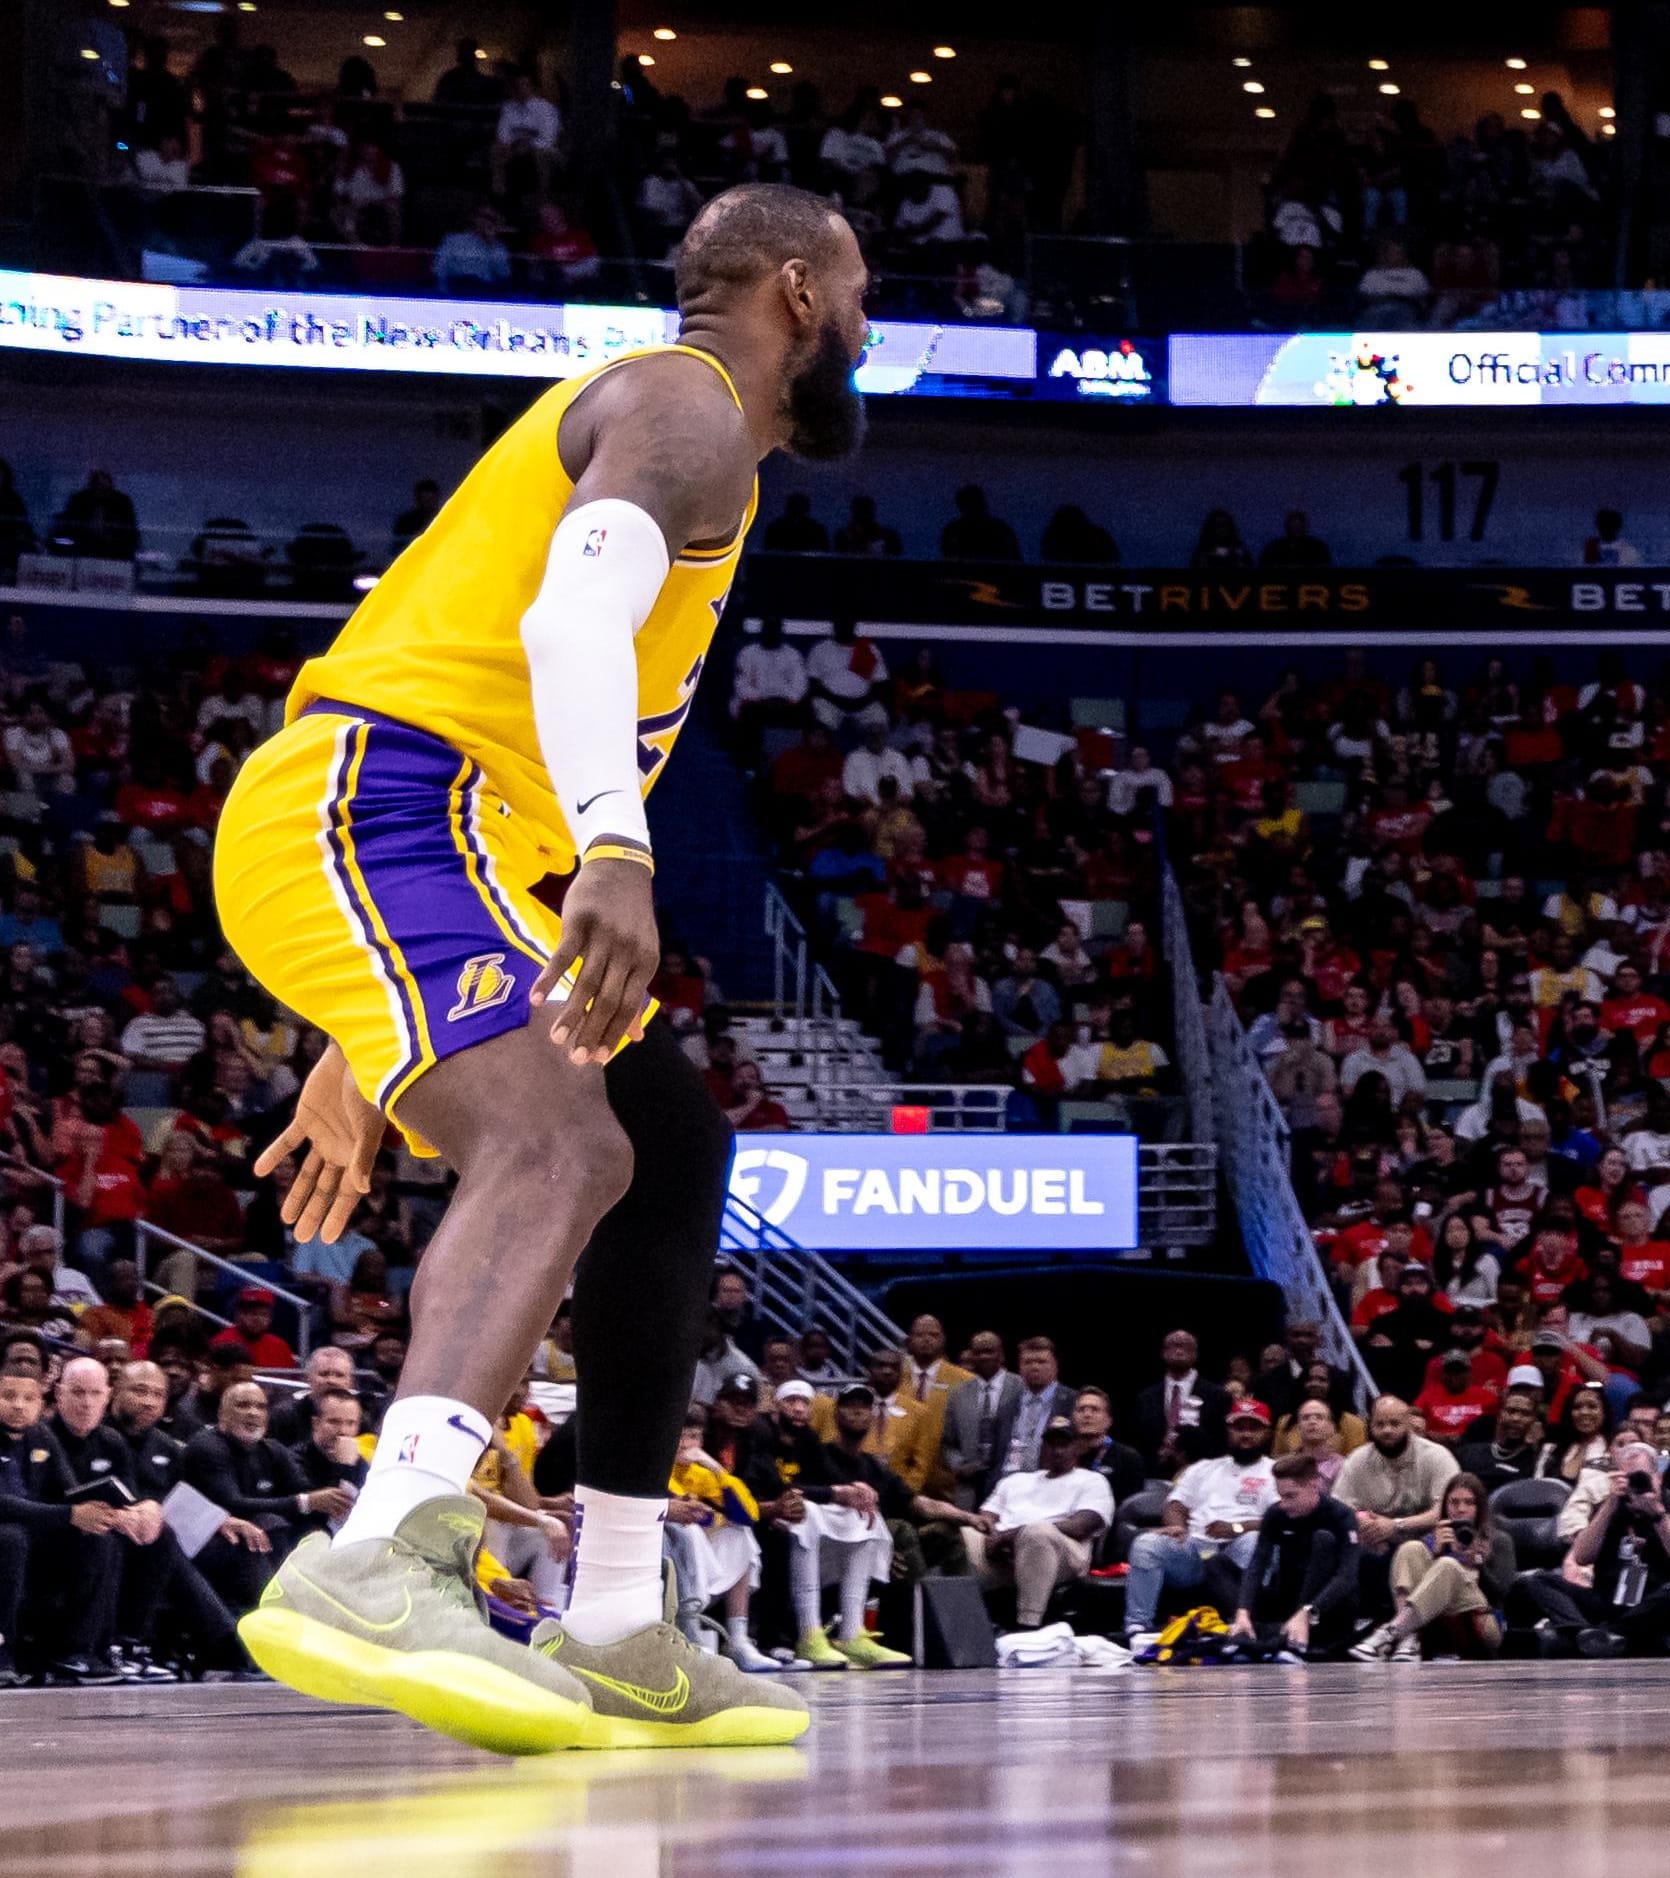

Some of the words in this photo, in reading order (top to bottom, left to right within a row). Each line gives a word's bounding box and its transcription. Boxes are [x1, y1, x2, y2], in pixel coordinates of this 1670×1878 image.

[240, 308, 286, 344] of
[292, 312, 350, 347] the
[356, 312, 440, 349] New
[1449, 352, 1575, 384] Official
[1400, 462, 1499, 541] 117
[1041, 582, 1370, 612] BETRIVERS
[822, 1168, 1105, 1216] FANDUEL
